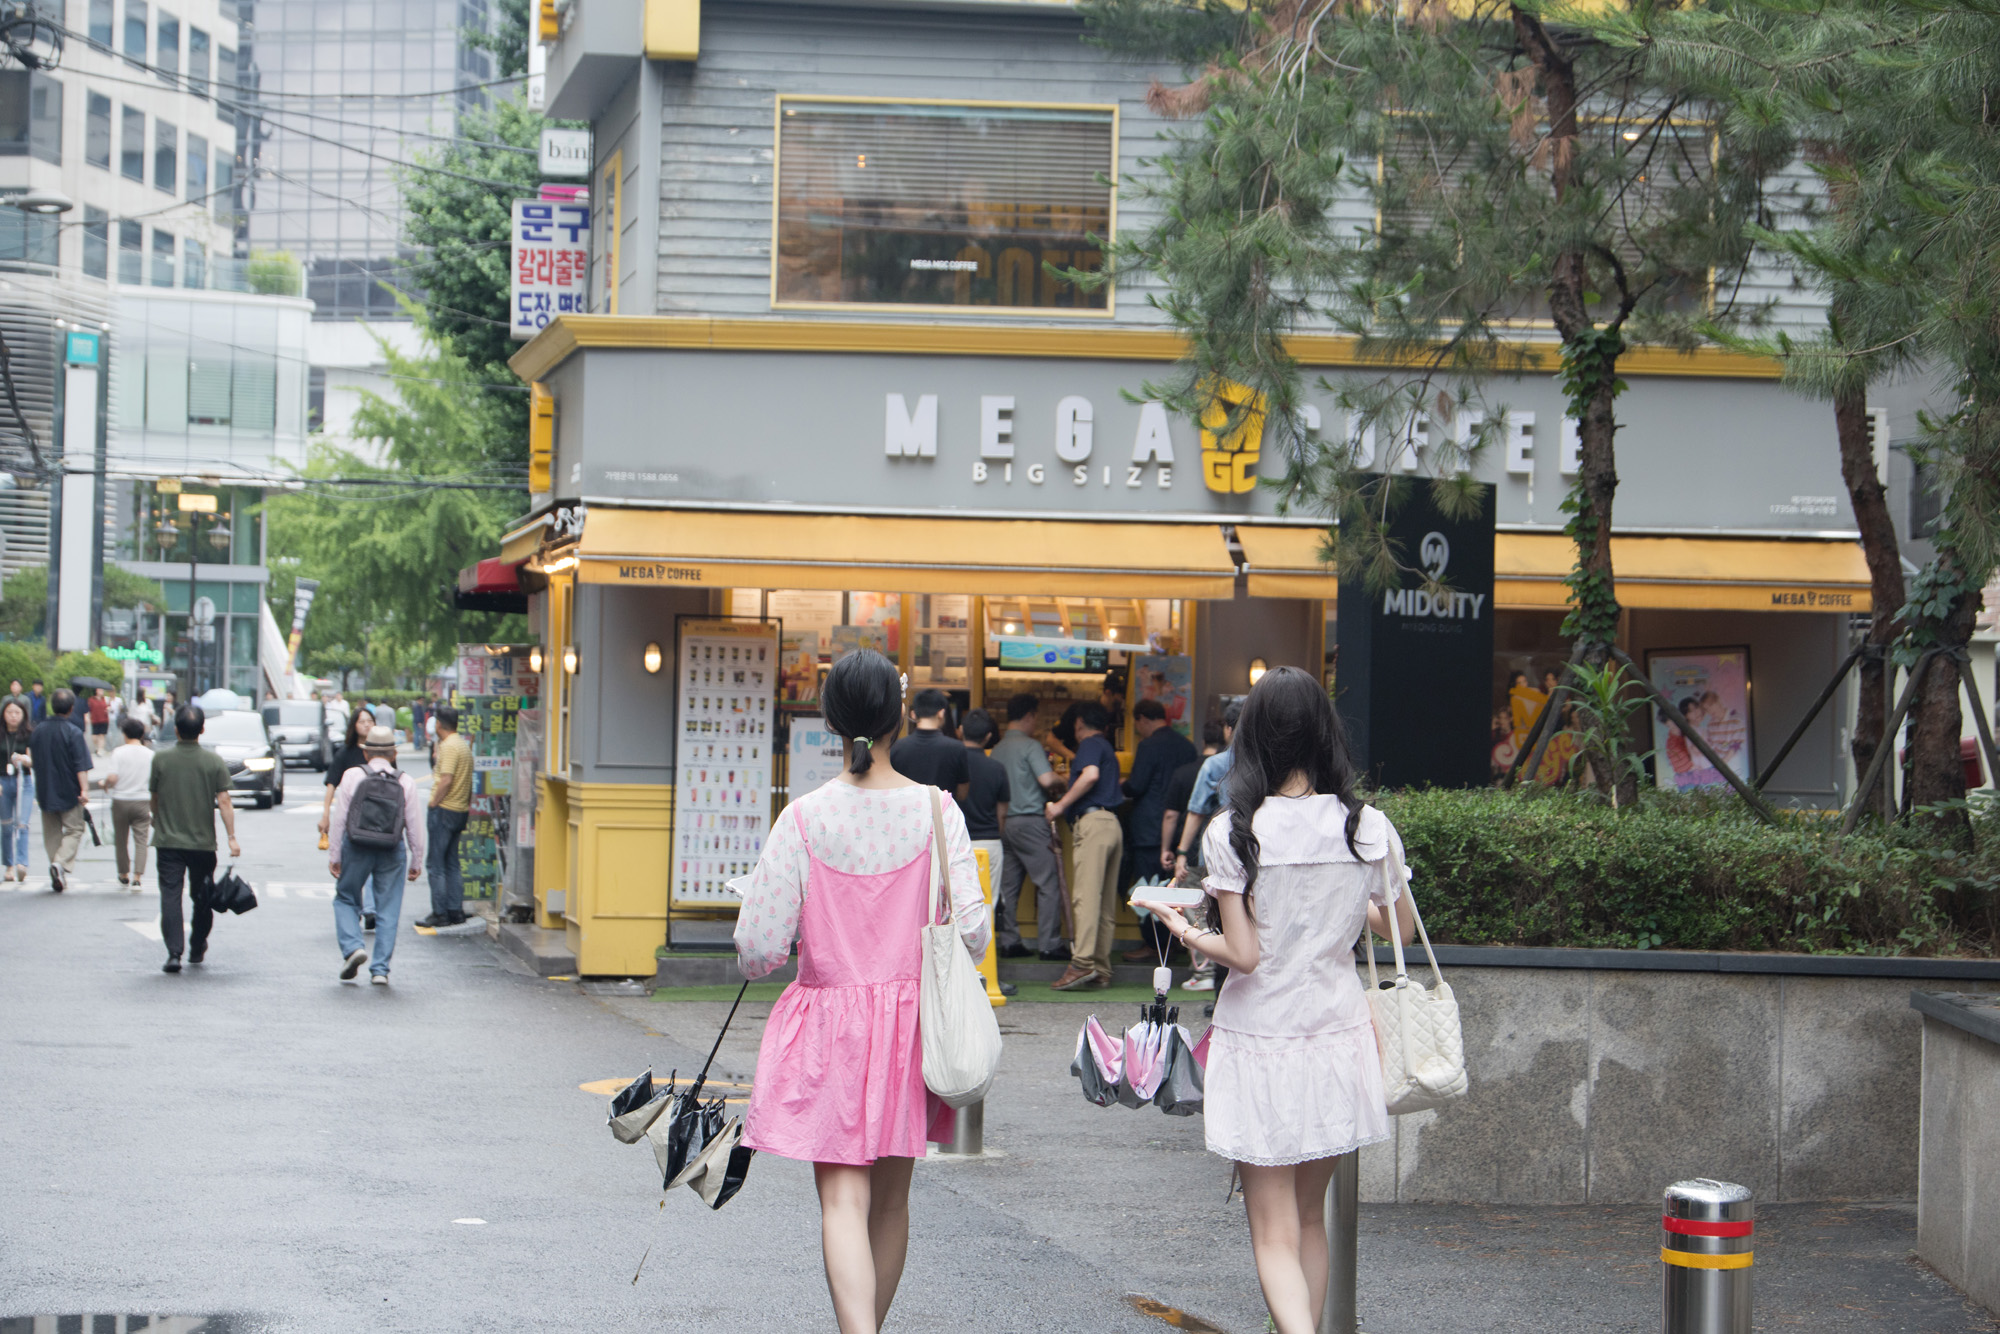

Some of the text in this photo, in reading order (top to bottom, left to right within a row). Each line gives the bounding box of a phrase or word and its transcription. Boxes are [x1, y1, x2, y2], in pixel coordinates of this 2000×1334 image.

[520, 203, 590, 243] 문구
[949, 261, 978, 272] COFFEE
[885, 392, 1175, 463] MEGA
[972, 462, 1173, 489] BIG SIZE
[619, 565, 702, 581] MEGA COFFEE
[1382, 588, 1486, 620] MIDCITY
[1771, 592, 1853, 606] MEGA COFFEE
[462, 657, 485, 694] 열쇠
[489, 657, 513, 695] 제본
